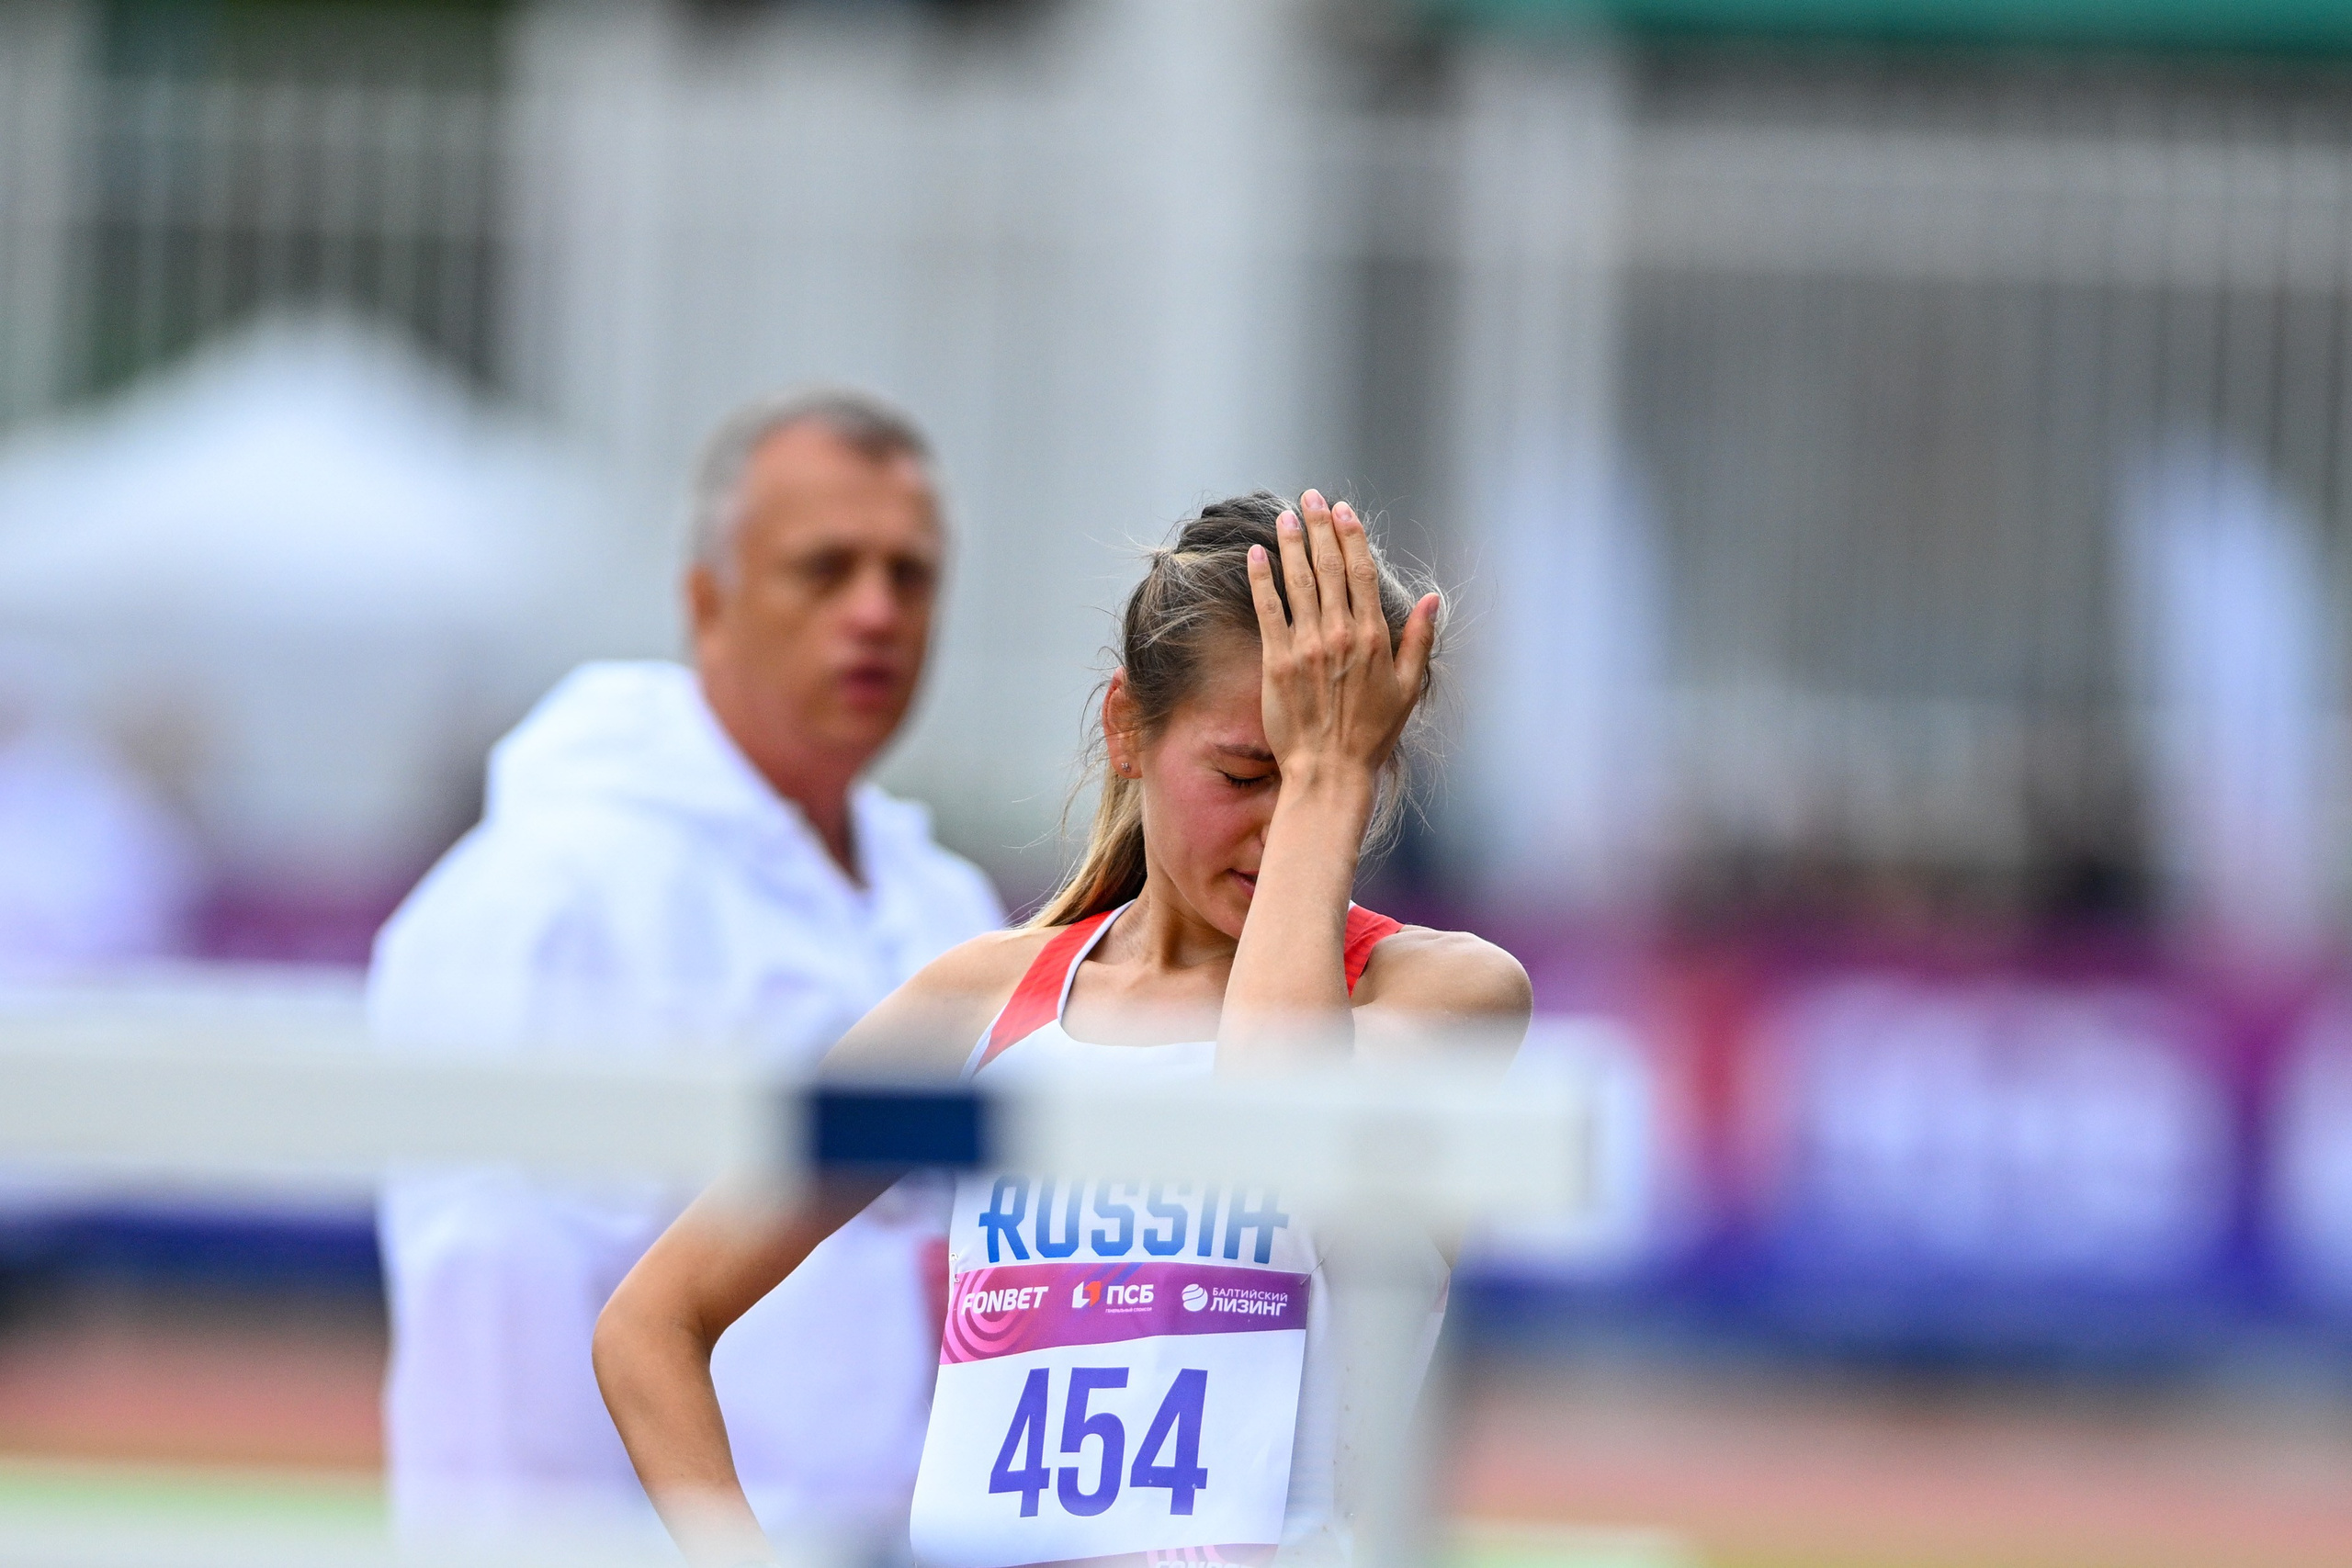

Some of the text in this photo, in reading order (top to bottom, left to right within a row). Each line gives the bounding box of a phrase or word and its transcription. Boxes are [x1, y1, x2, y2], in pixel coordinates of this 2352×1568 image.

[978, 1174, 1288, 1264] RUSSIA
[961, 1286, 1049, 1315] FONBET
[1106, 1284, 1154, 1304] ПСБ
[1210, 1297, 1287, 1315] ЛИЗИНГ
[1213, 1287, 1287, 1302] БАЛТИЙСКИЙ
[989, 1367, 1208, 1517] 454
